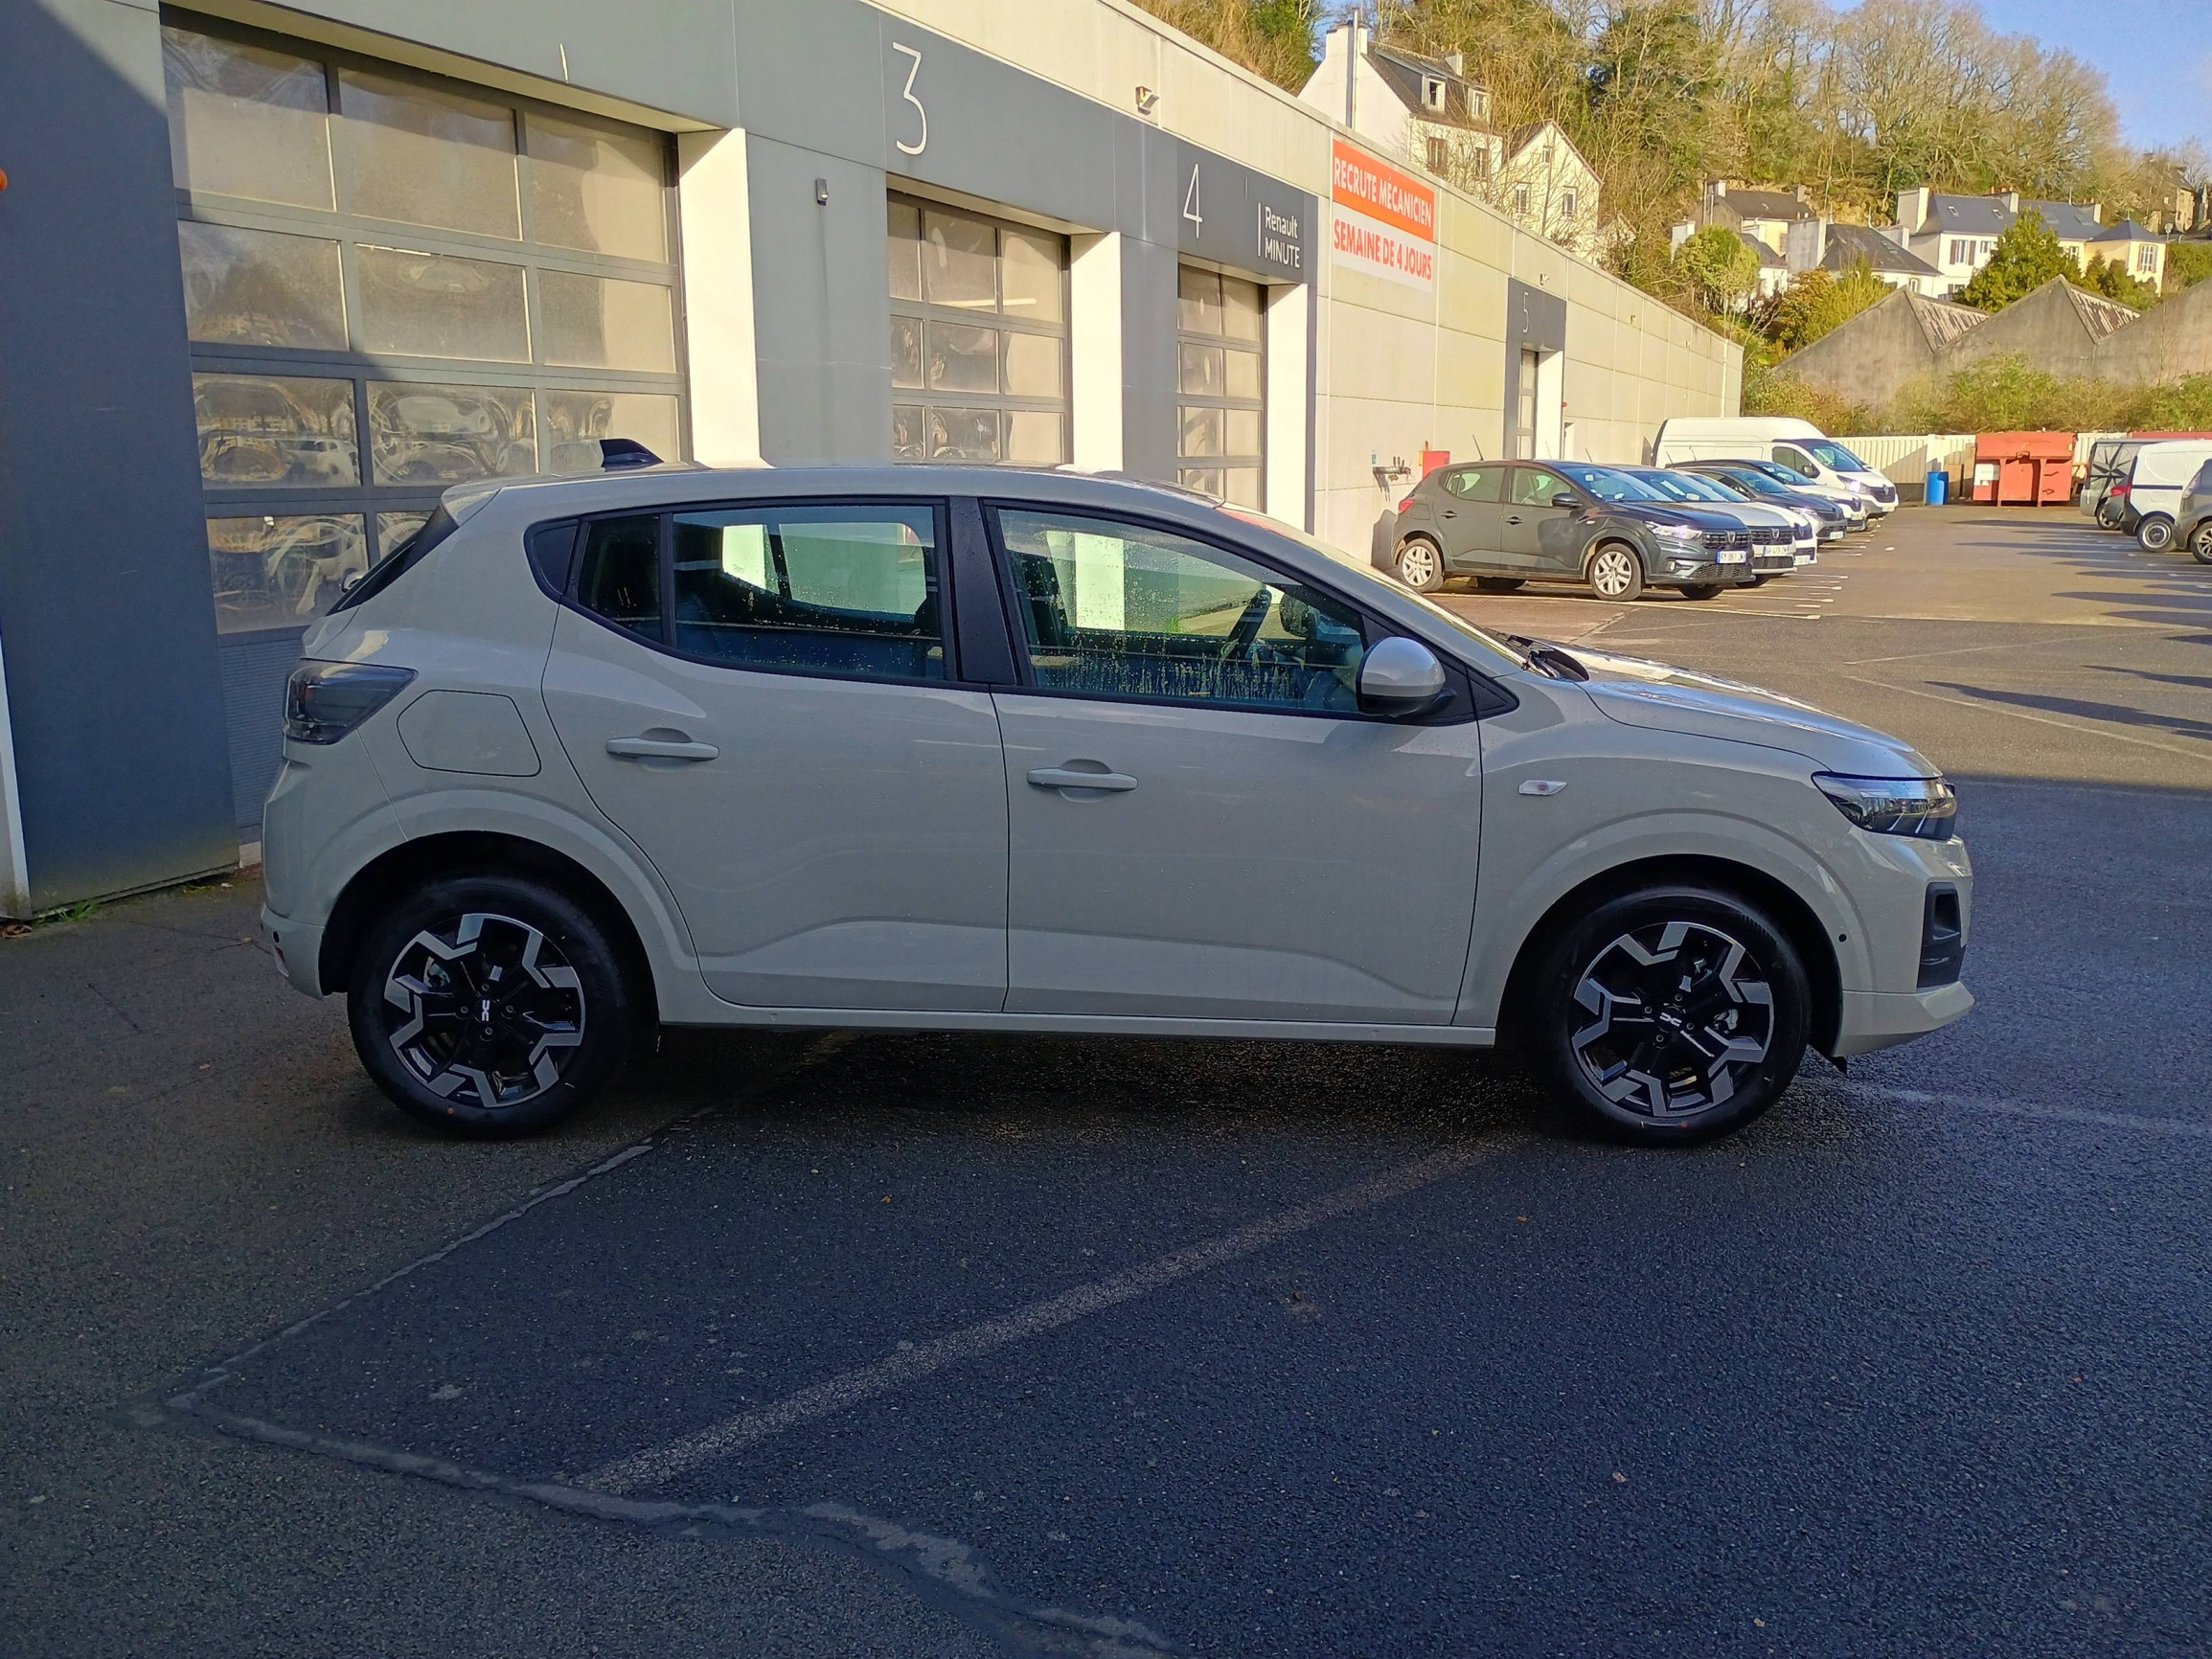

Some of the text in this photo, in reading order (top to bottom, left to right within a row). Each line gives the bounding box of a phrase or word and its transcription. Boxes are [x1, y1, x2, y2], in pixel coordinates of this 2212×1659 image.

[892, 41, 928, 155] 3
[1182, 163, 1203, 239] 4
[1265, 206, 1298, 239] Renault
[1334, 156, 1432, 228] RECRUTE MÉCANICIEN
[1265, 237, 1301, 268] MINUTE
[1334, 218, 1432, 281] SEMAINE DE 4 JOURS
[1522, 291, 1530, 333] 5
